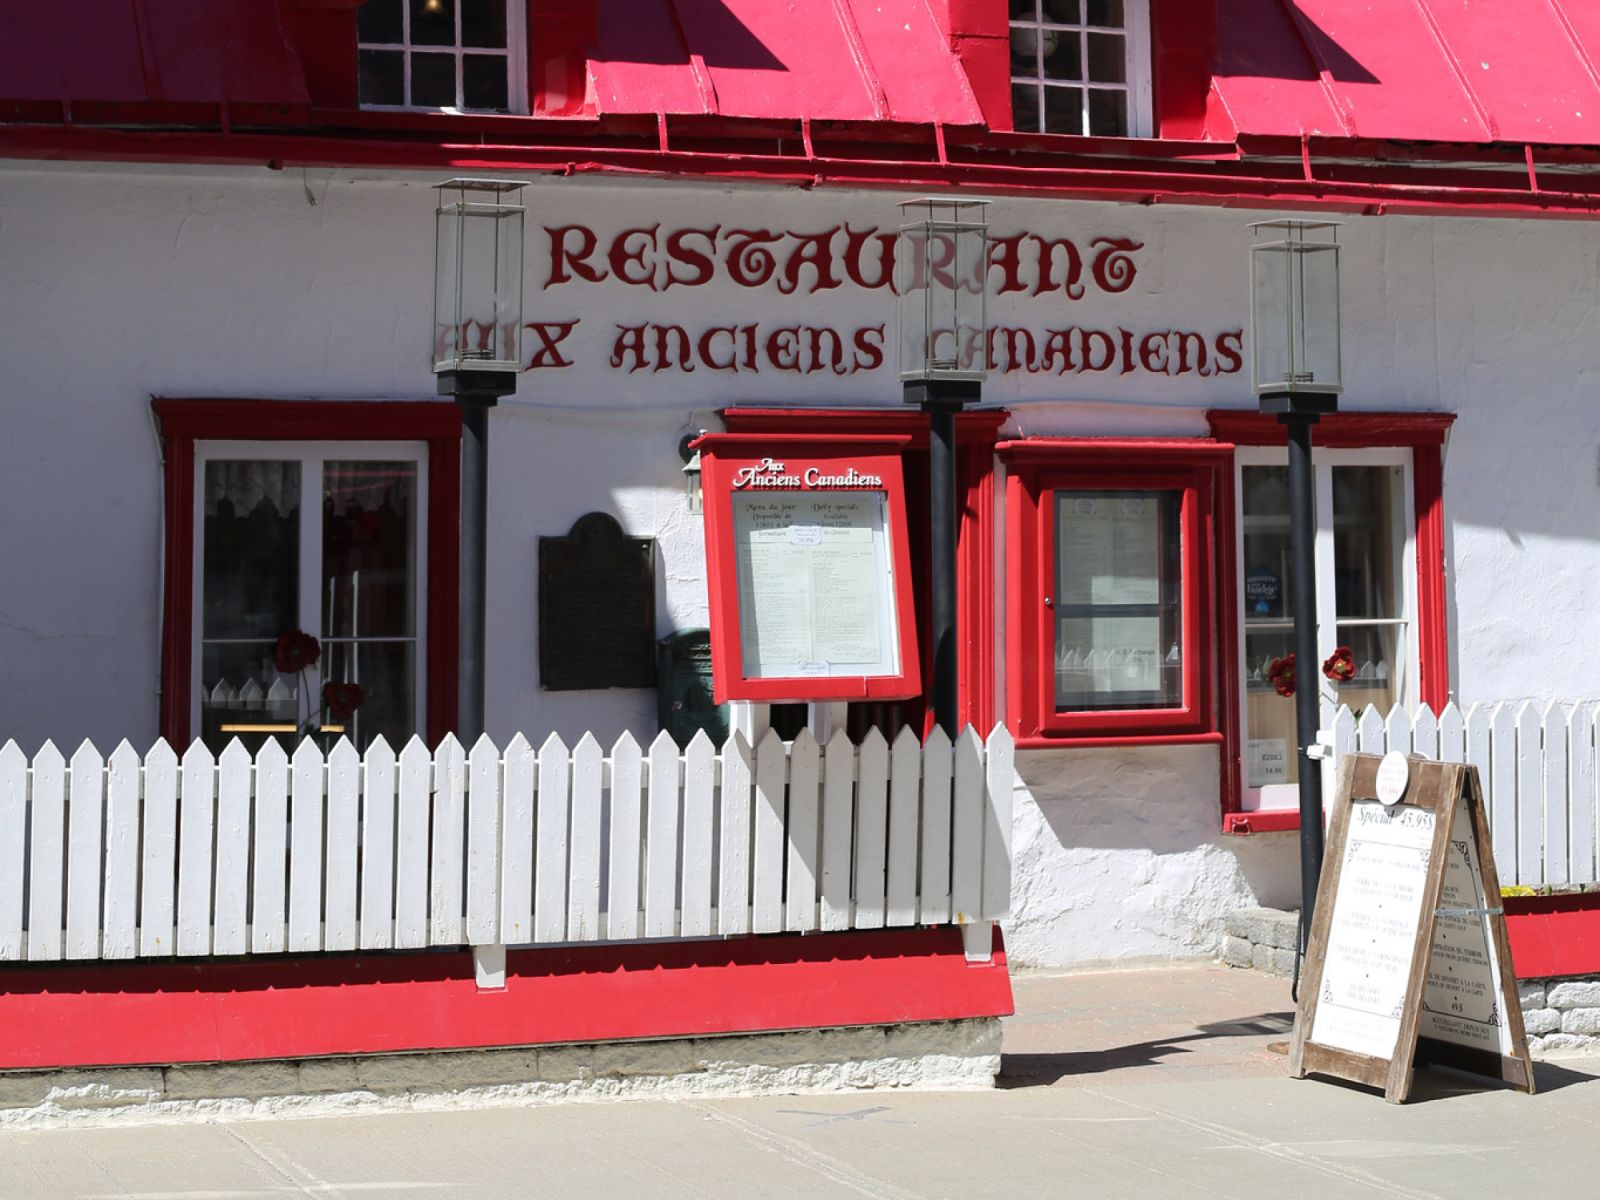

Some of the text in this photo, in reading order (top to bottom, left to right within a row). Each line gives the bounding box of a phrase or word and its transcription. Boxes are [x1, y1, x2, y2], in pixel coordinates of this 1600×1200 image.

[543, 222, 1144, 300] RESTAURANT
[437, 318, 1243, 377] AUX ANCIENS CANADIENS
[756, 458, 784, 472] Aux
[733, 467, 883, 487] Anciens Canadiens
[1360, 807, 1395, 826] Spécial
